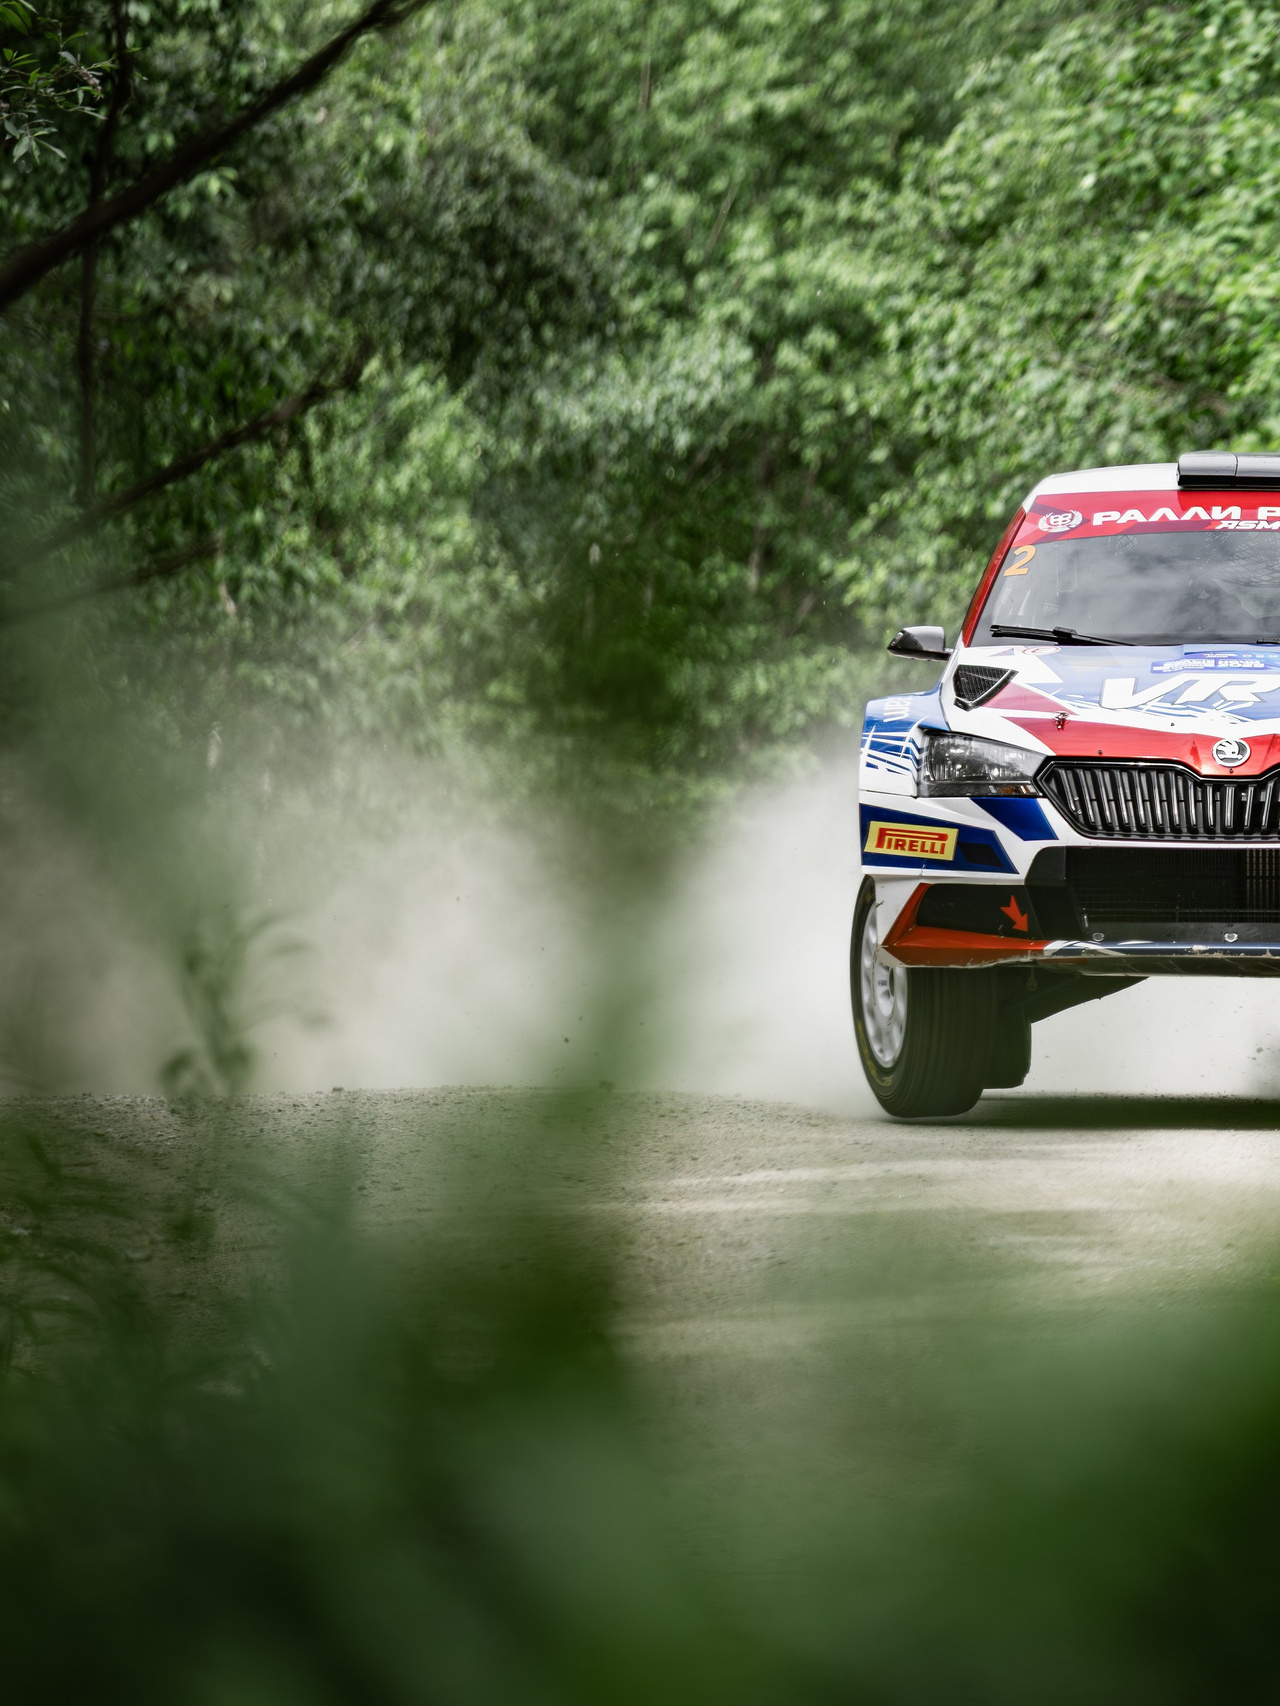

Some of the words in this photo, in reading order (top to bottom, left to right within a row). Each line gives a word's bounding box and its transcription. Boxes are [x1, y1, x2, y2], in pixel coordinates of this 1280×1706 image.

[1092, 506, 1242, 526] РАЛЛИ
[1003, 544, 1036, 576] 2
[875, 827, 949, 855] PIRELLI
